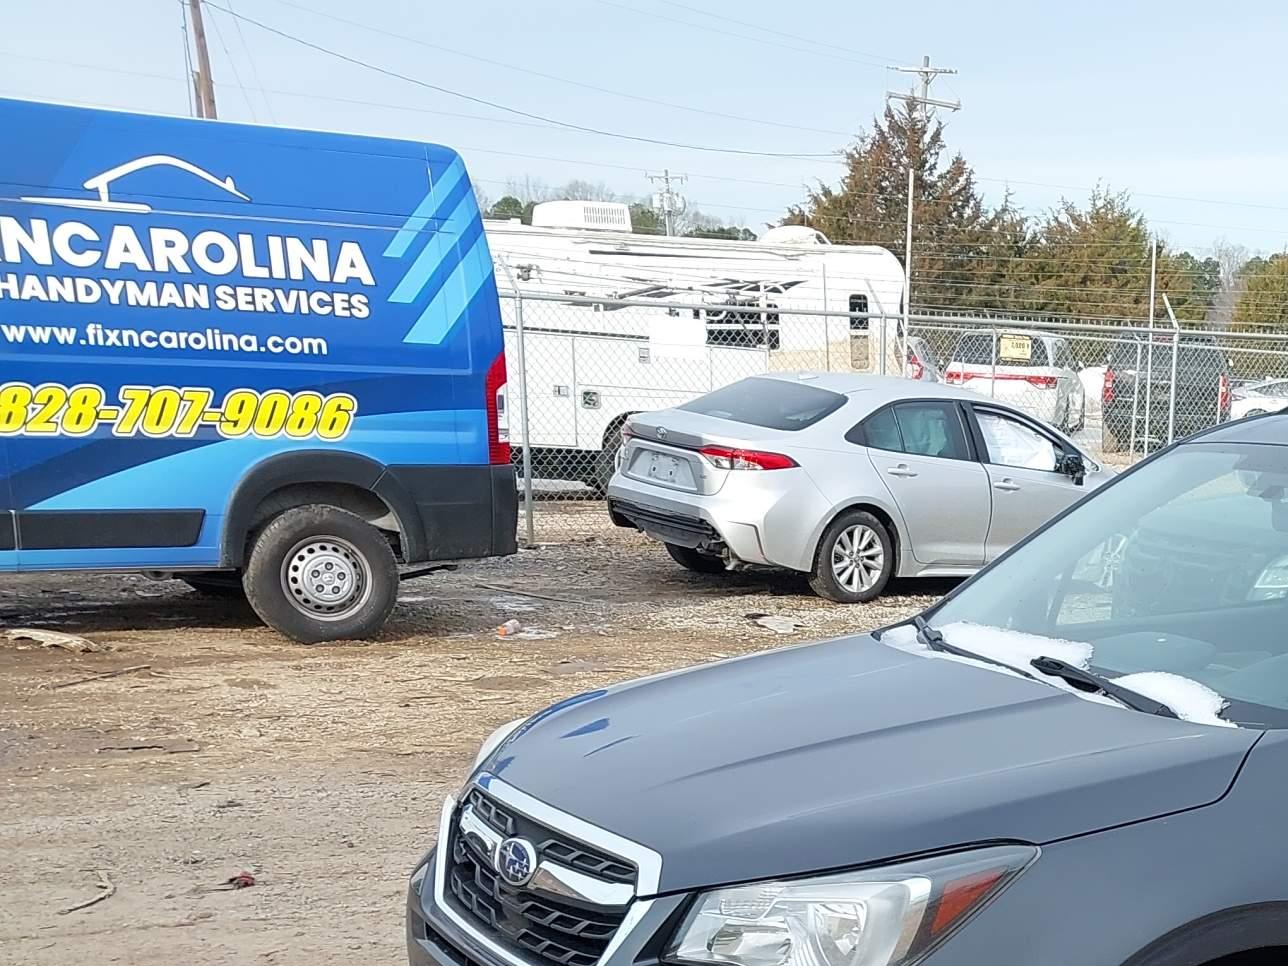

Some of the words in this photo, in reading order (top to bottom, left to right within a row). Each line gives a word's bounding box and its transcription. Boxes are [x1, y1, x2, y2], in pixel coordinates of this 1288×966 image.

[0, 216, 376, 287] NCAROLINA
[0, 273, 210, 309] HANDYMAN
[215, 285, 370, 319] SERVICES
[1, 322, 328, 355] www.fixncarolina.com
[0, 384, 356, 440] 828-707-9086
